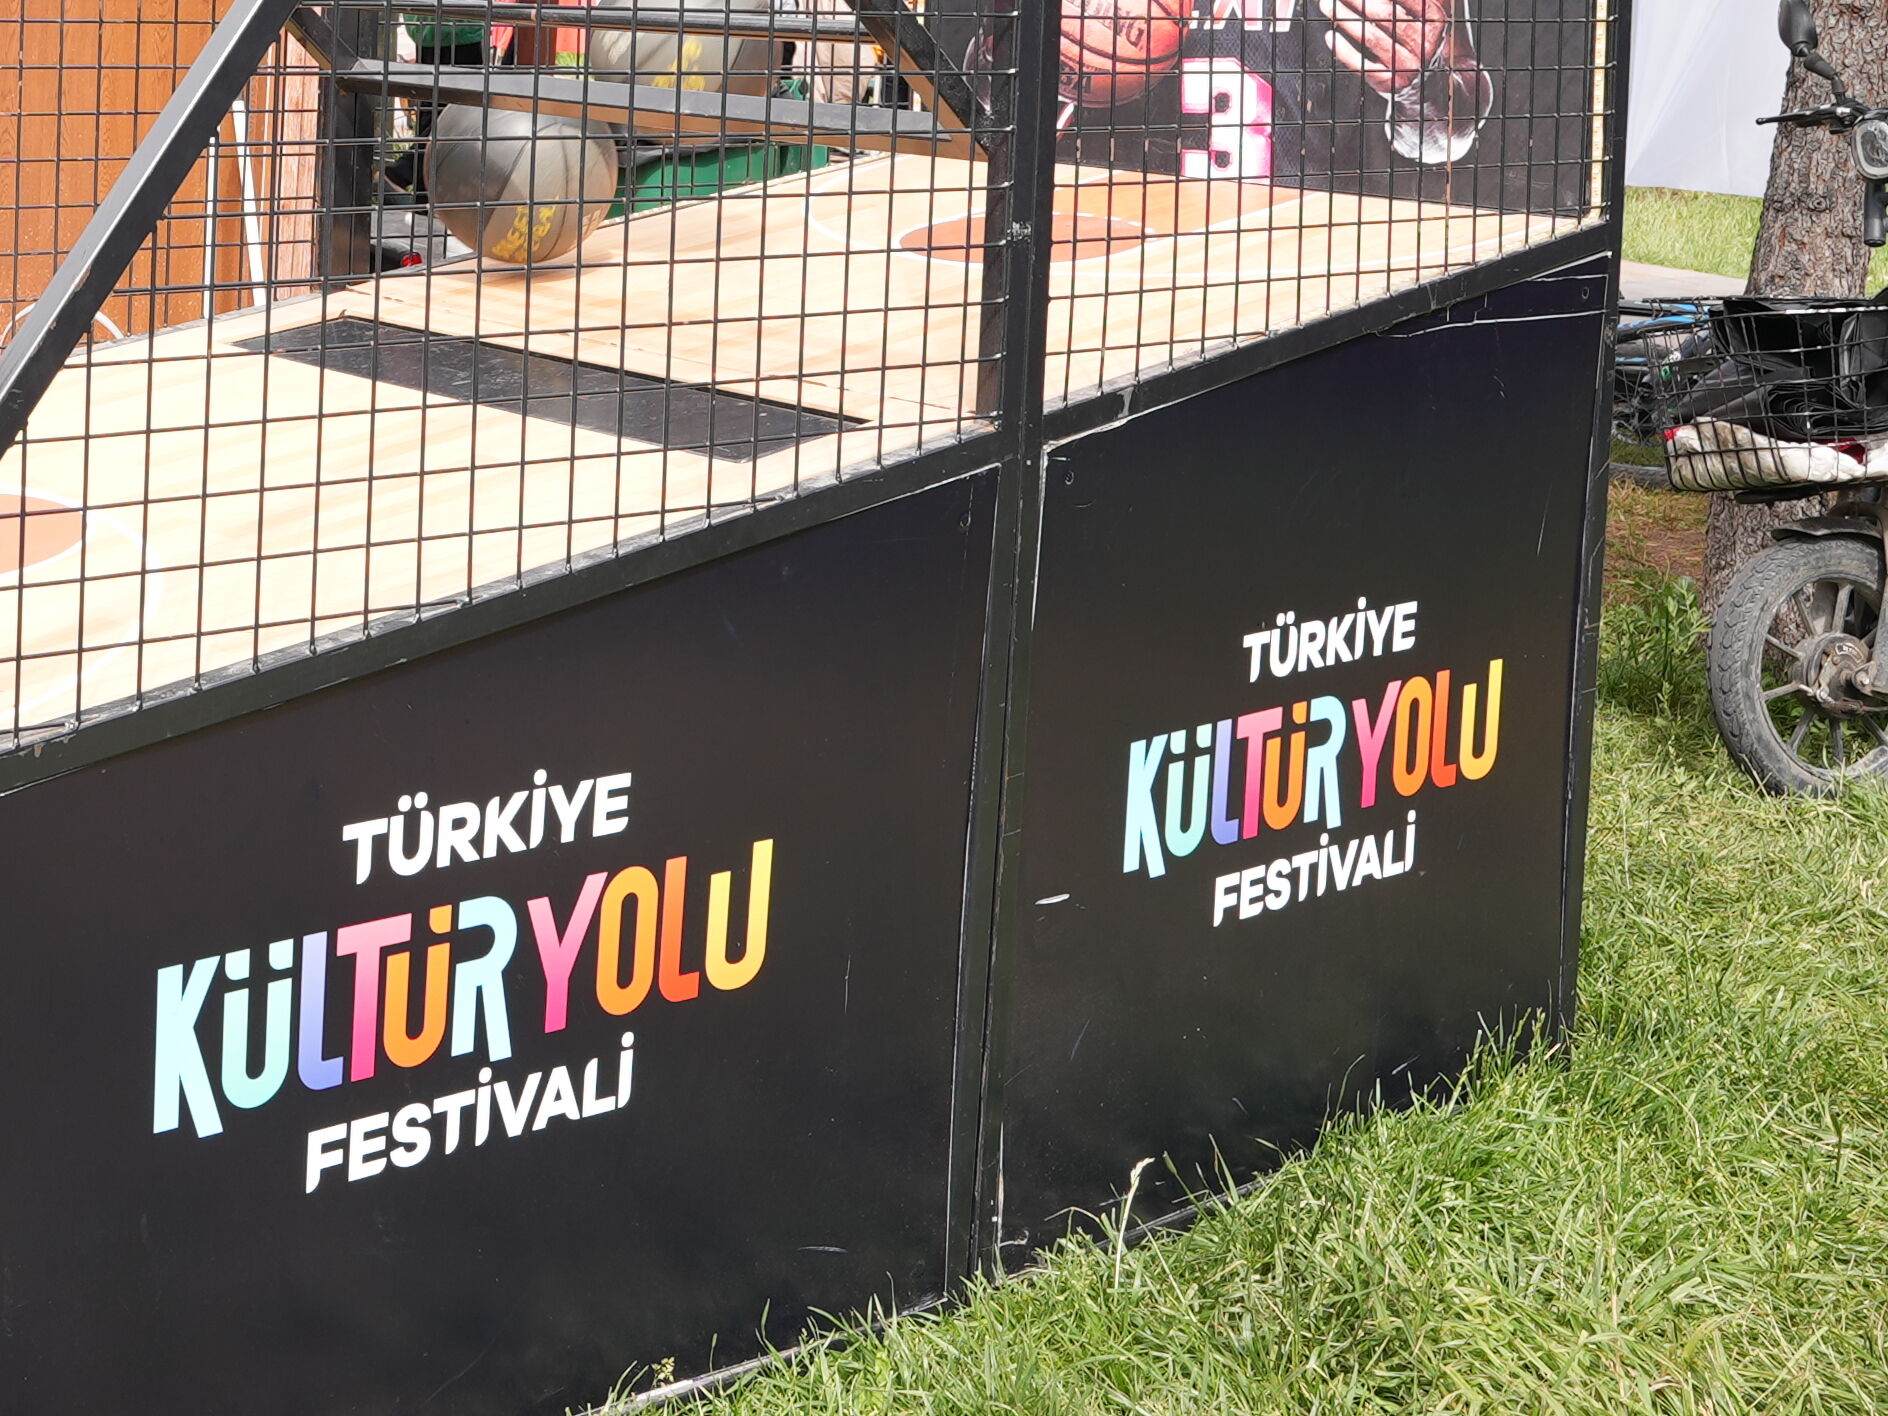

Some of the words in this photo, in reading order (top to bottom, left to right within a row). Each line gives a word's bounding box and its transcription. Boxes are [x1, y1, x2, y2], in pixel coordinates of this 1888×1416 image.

[1181, 57, 1273, 184] 3
[1243, 596, 1418, 682] TÜRKİYE
[342, 769, 632, 884] TÜRKİYE
[1123, 695, 1347, 878] KÜLTÜR
[1352, 658, 1503, 808] YOLU
[1213, 810, 1417, 927] FESTİVALİ
[153, 896, 518, 1138] KÜLTÜR
[527, 838, 774, 1033] YOLU
[306, 1031, 634, 1194] FESTİVALİ
